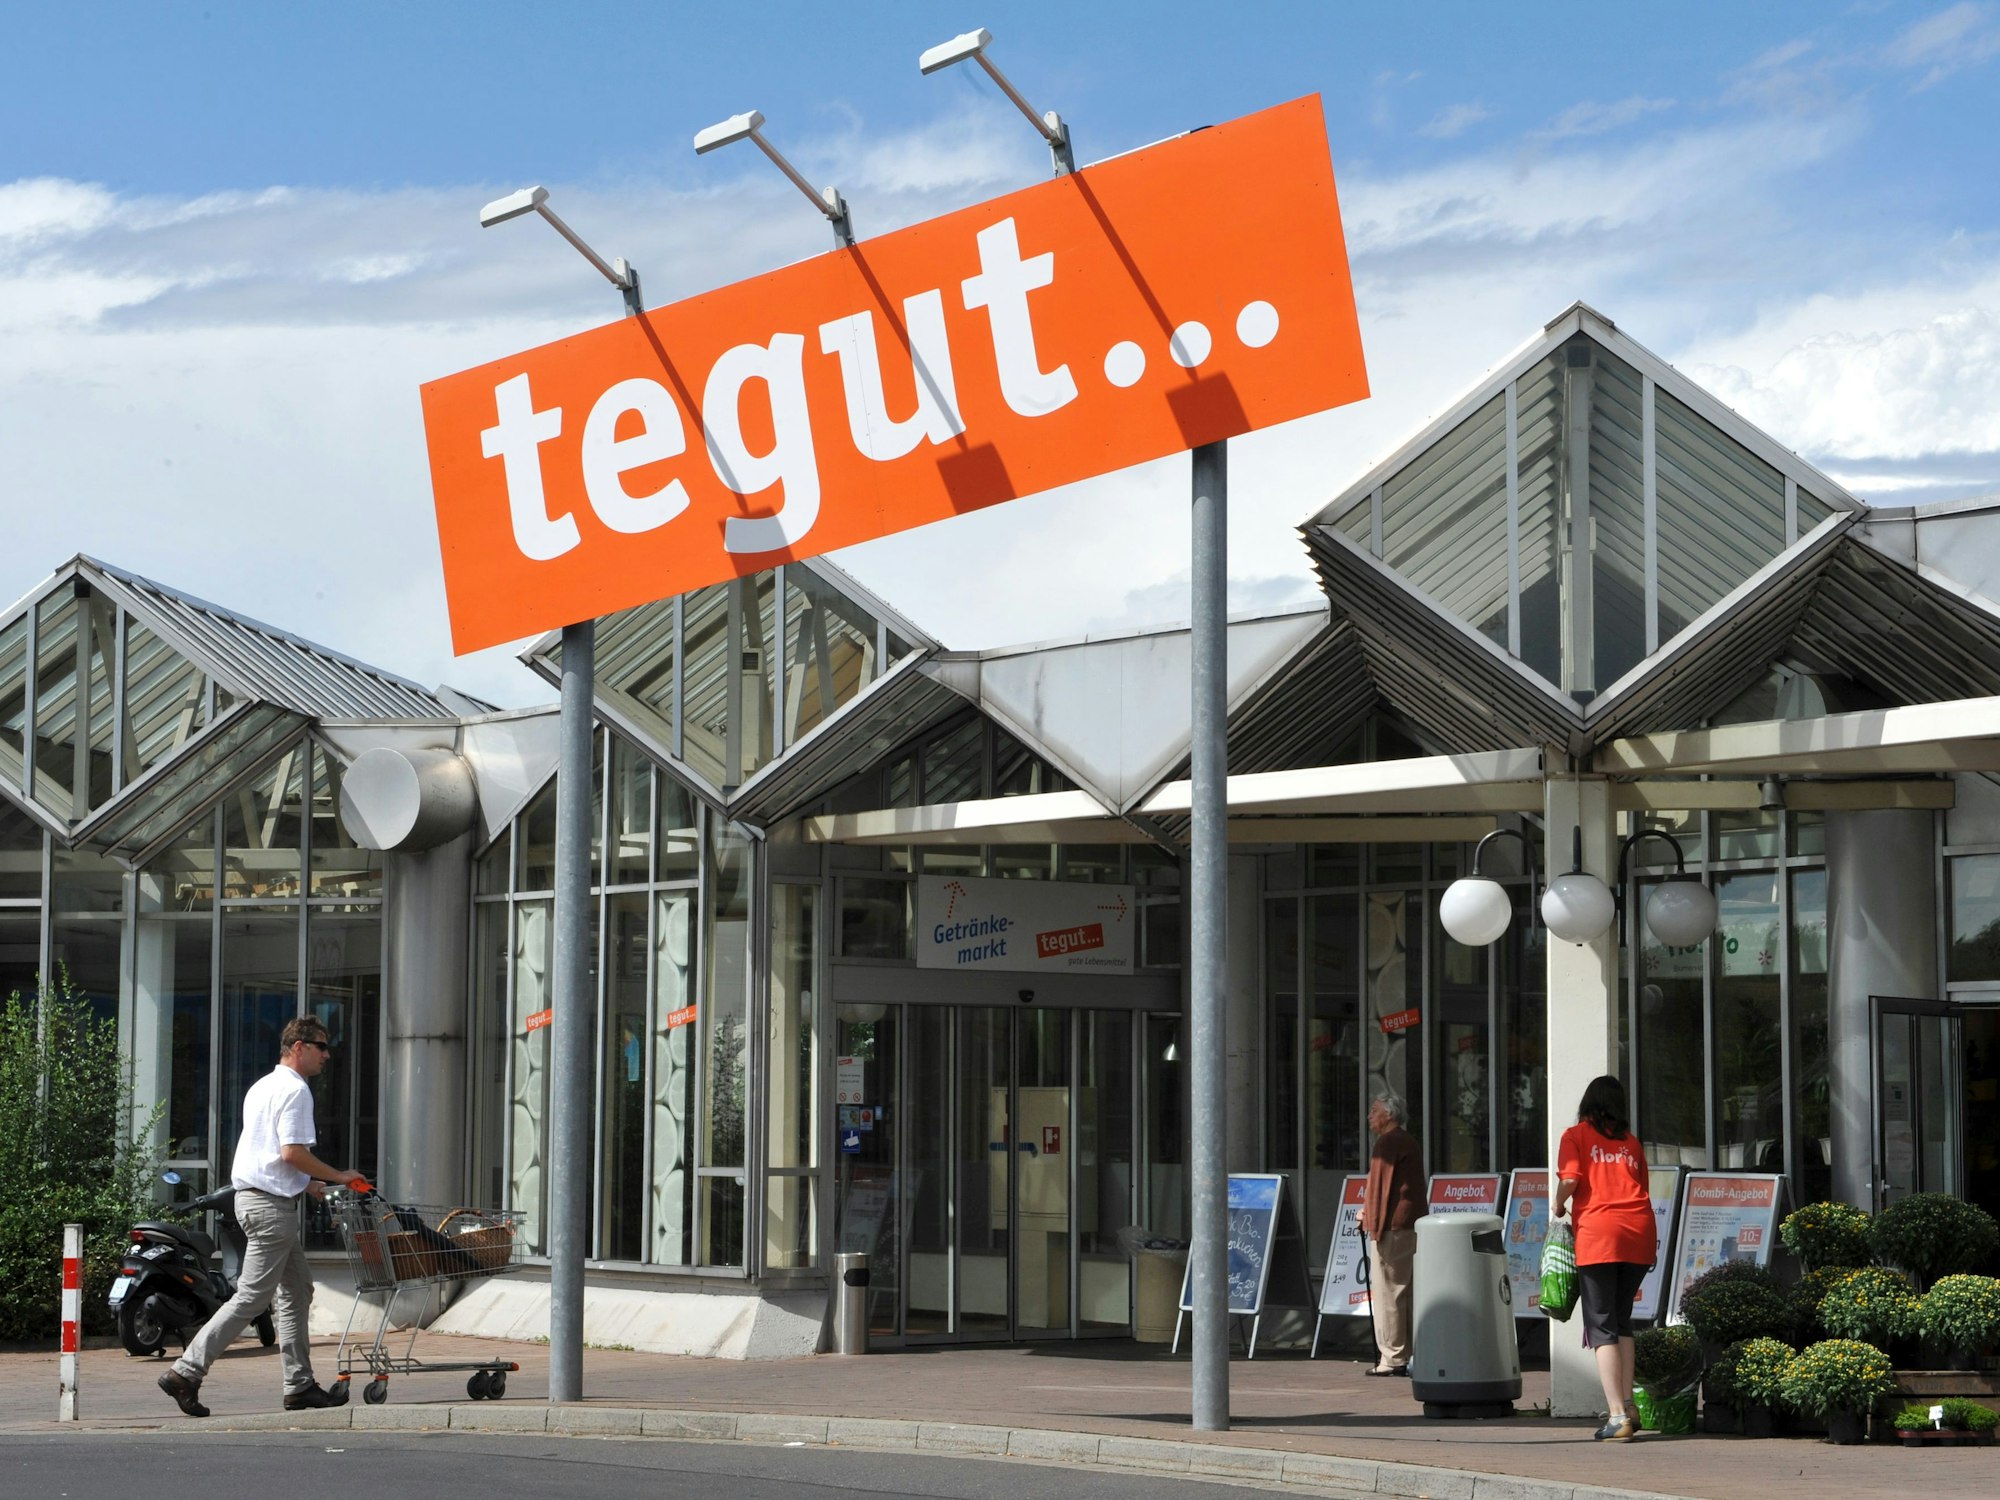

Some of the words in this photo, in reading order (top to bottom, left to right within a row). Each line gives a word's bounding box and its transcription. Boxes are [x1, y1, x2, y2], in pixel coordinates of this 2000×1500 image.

[480, 216, 1280, 562] tegut...
[933, 914, 1015, 944] Getränke-
[957, 938, 1008, 964] markt
[1040, 928, 1101, 953] tegut...
[1068, 956, 1084, 967] gute
[1084, 956, 1128, 968] Lebensmittel
[1383, 1012, 1417, 1029] tegut...
[1444, 1184, 1485, 1200] Angebot
[1693, 1186, 1769, 1201] Kombi-Angebot
